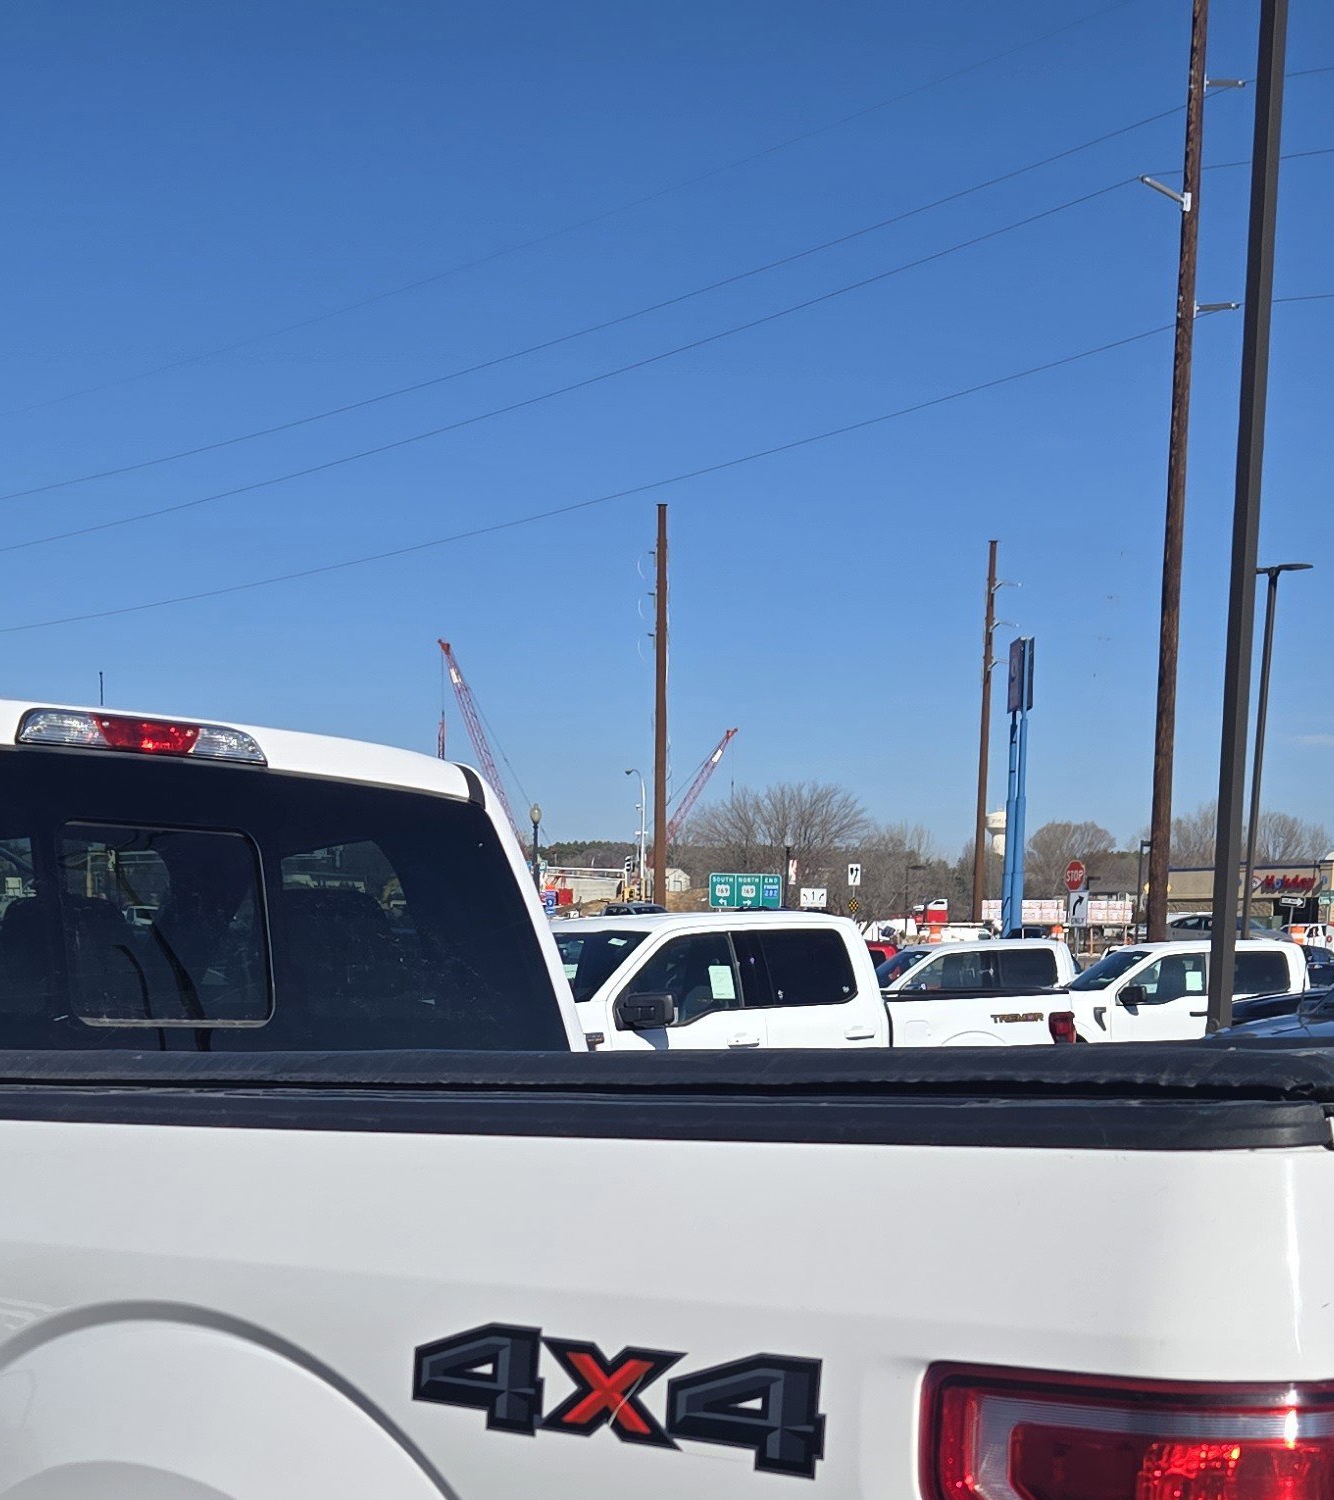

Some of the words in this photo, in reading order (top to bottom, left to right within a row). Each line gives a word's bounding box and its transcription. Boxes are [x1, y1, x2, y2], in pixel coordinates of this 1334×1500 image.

[1066, 870, 1084, 882] STOP
[1070, 917, 1085, 925] ONLY
[990, 1012, 1044, 1023] TREMOR
